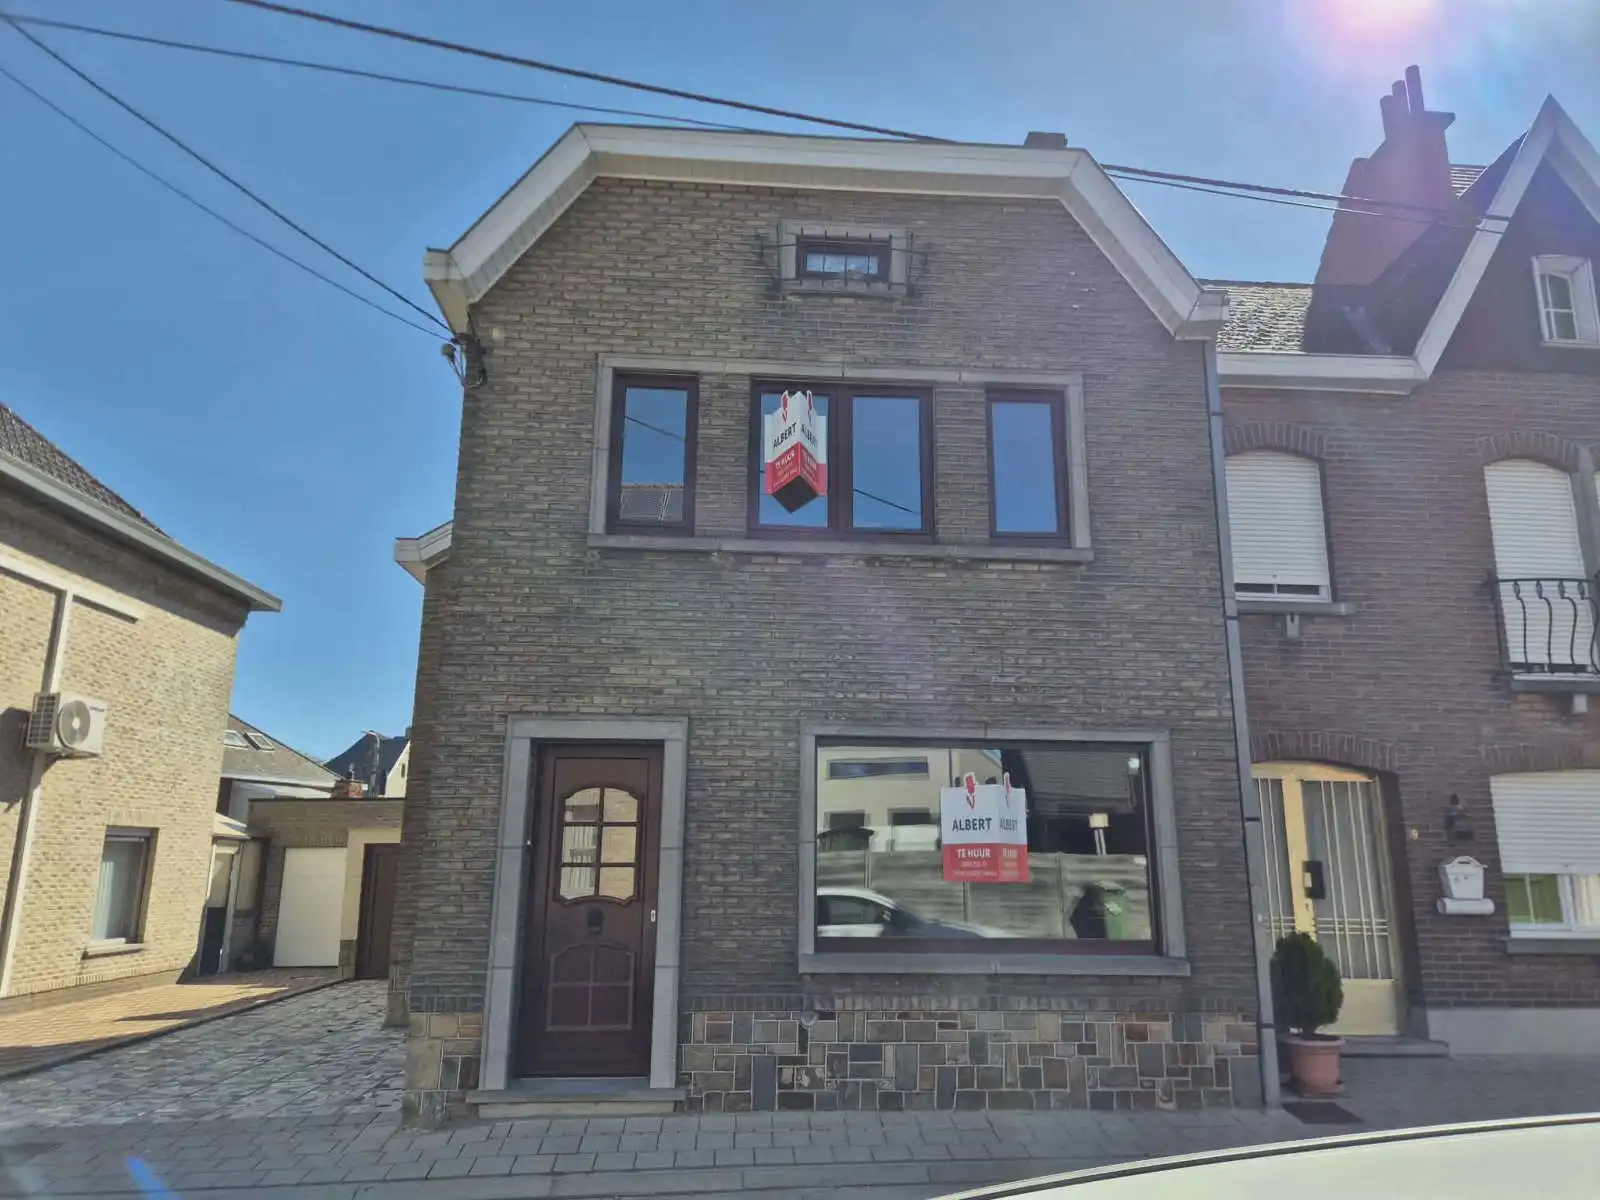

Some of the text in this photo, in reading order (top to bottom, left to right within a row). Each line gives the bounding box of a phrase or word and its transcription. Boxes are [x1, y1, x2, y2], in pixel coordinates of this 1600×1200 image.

[773, 422, 797, 448] ALBERT
[952, 818, 992, 831] ALBERT
[956, 848, 966, 858] TE
[967, 848, 991, 858] HUUR
